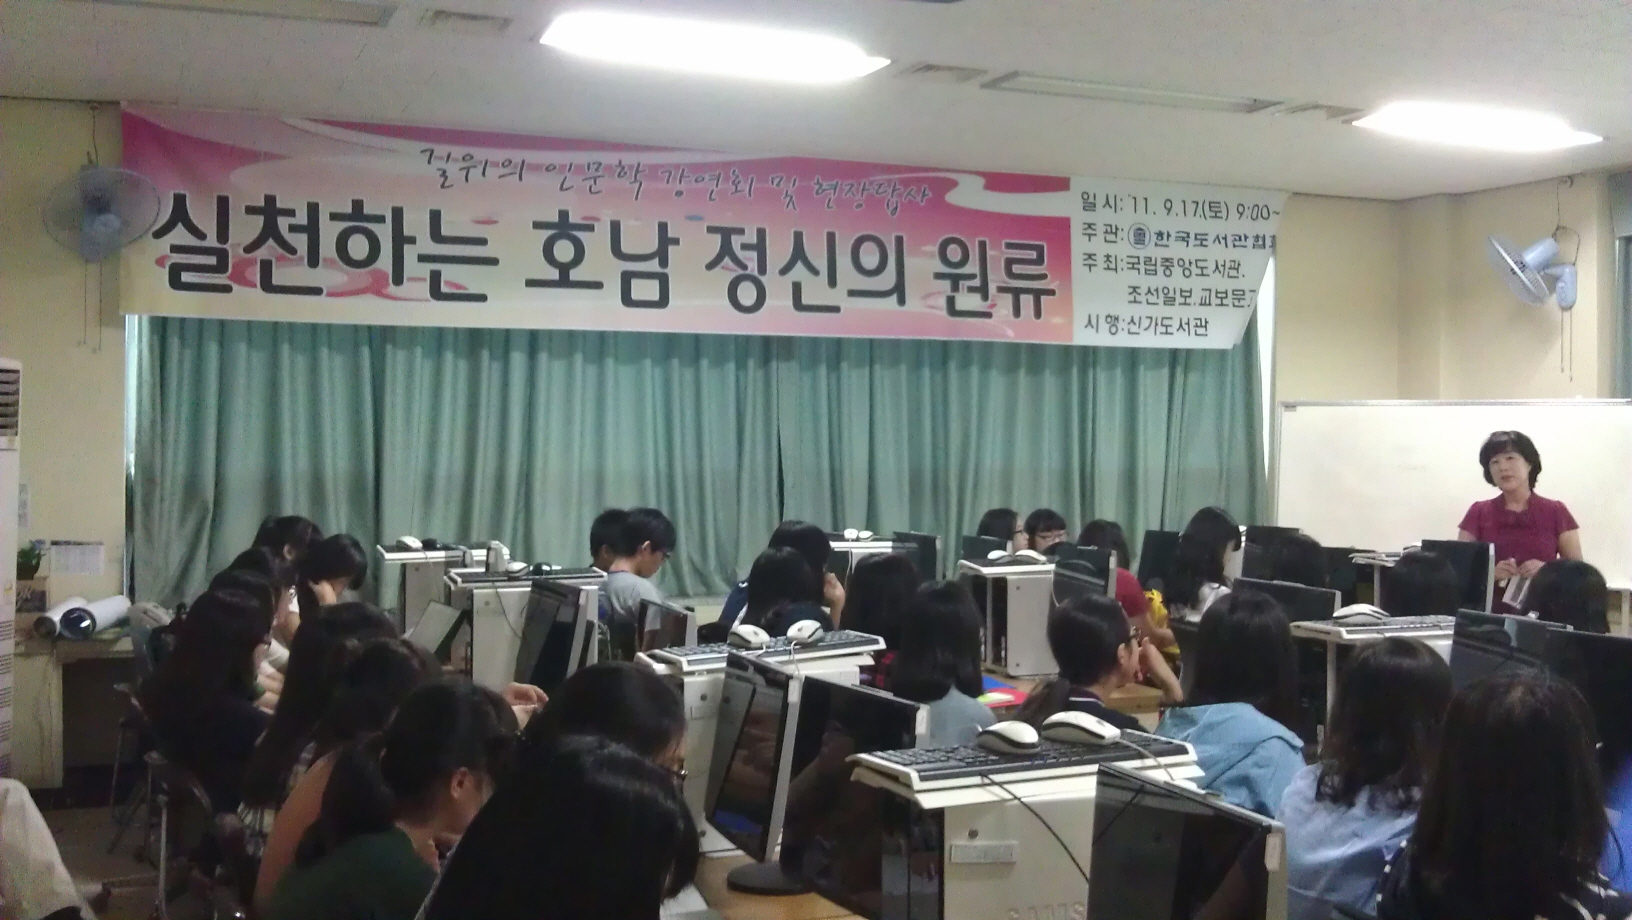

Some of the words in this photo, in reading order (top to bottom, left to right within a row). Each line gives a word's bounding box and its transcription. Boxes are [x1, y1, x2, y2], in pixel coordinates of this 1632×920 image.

[545, 159, 647, 201] 인문학
[659, 168, 755, 201] 강연회
[770, 175, 797, 211] 및
[813, 176, 931, 216] 현장답사
[152, 193, 500, 303] 실천하는
[524, 208, 681, 309] 호남
[704, 224, 907, 314] 정신의
[932, 236, 1057, 320] 원류
